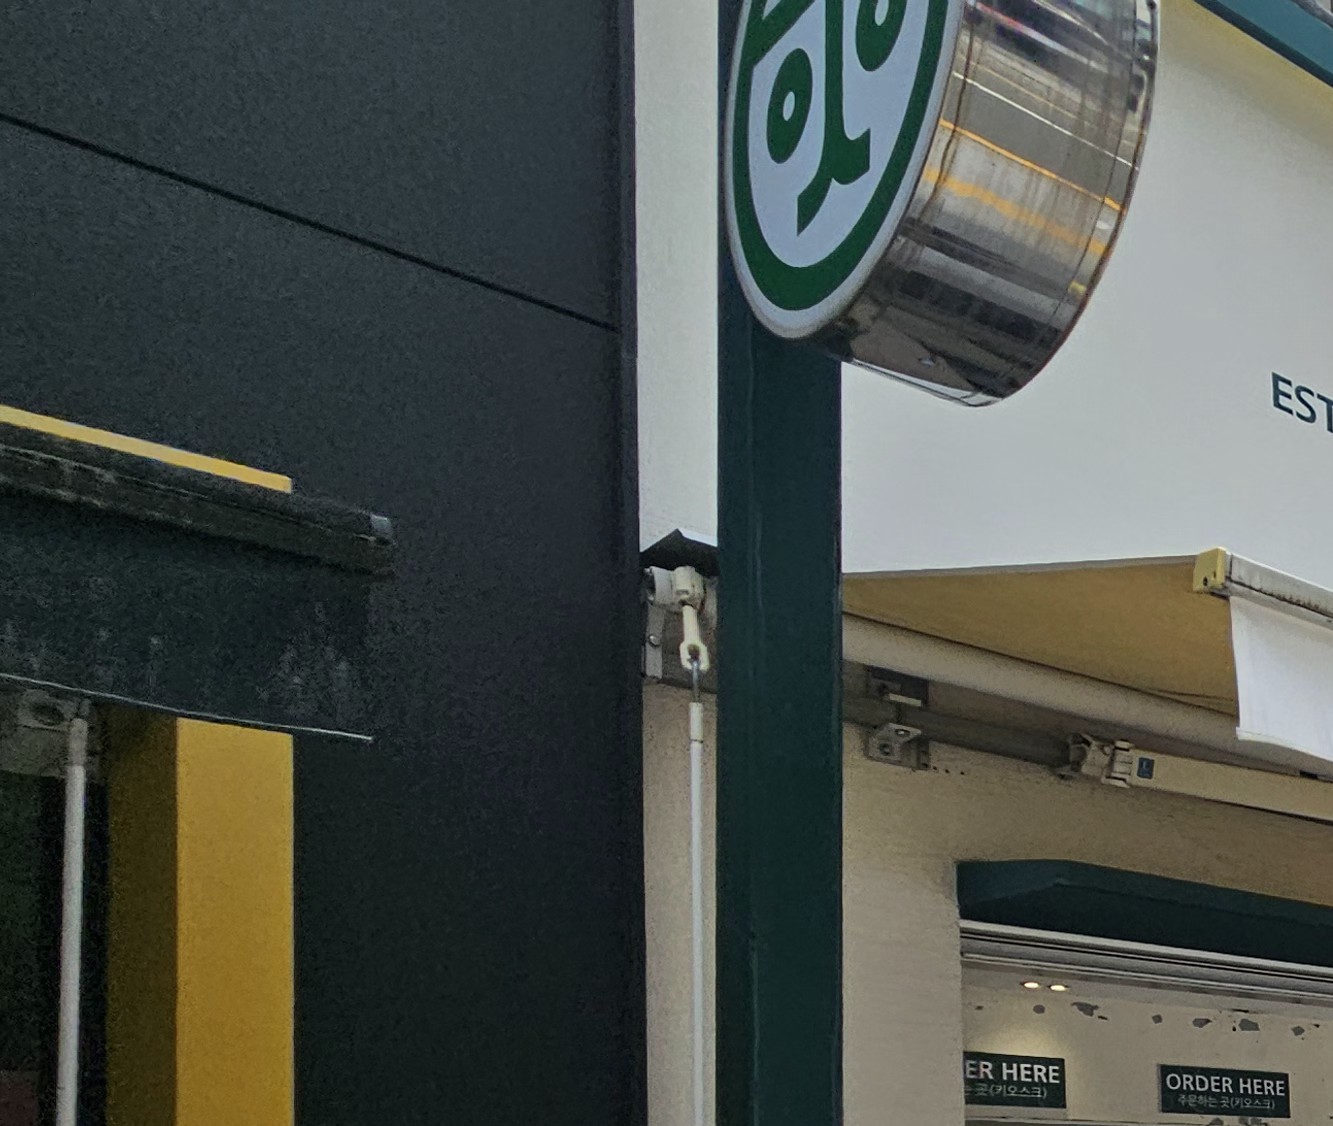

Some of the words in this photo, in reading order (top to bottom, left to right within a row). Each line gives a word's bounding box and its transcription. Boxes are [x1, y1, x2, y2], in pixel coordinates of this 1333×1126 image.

[1002, 1063, 1060, 1083] HERE
[1166, 1073, 1232, 1093] ORDER
[1239, 1077, 1286, 1096] HERE
